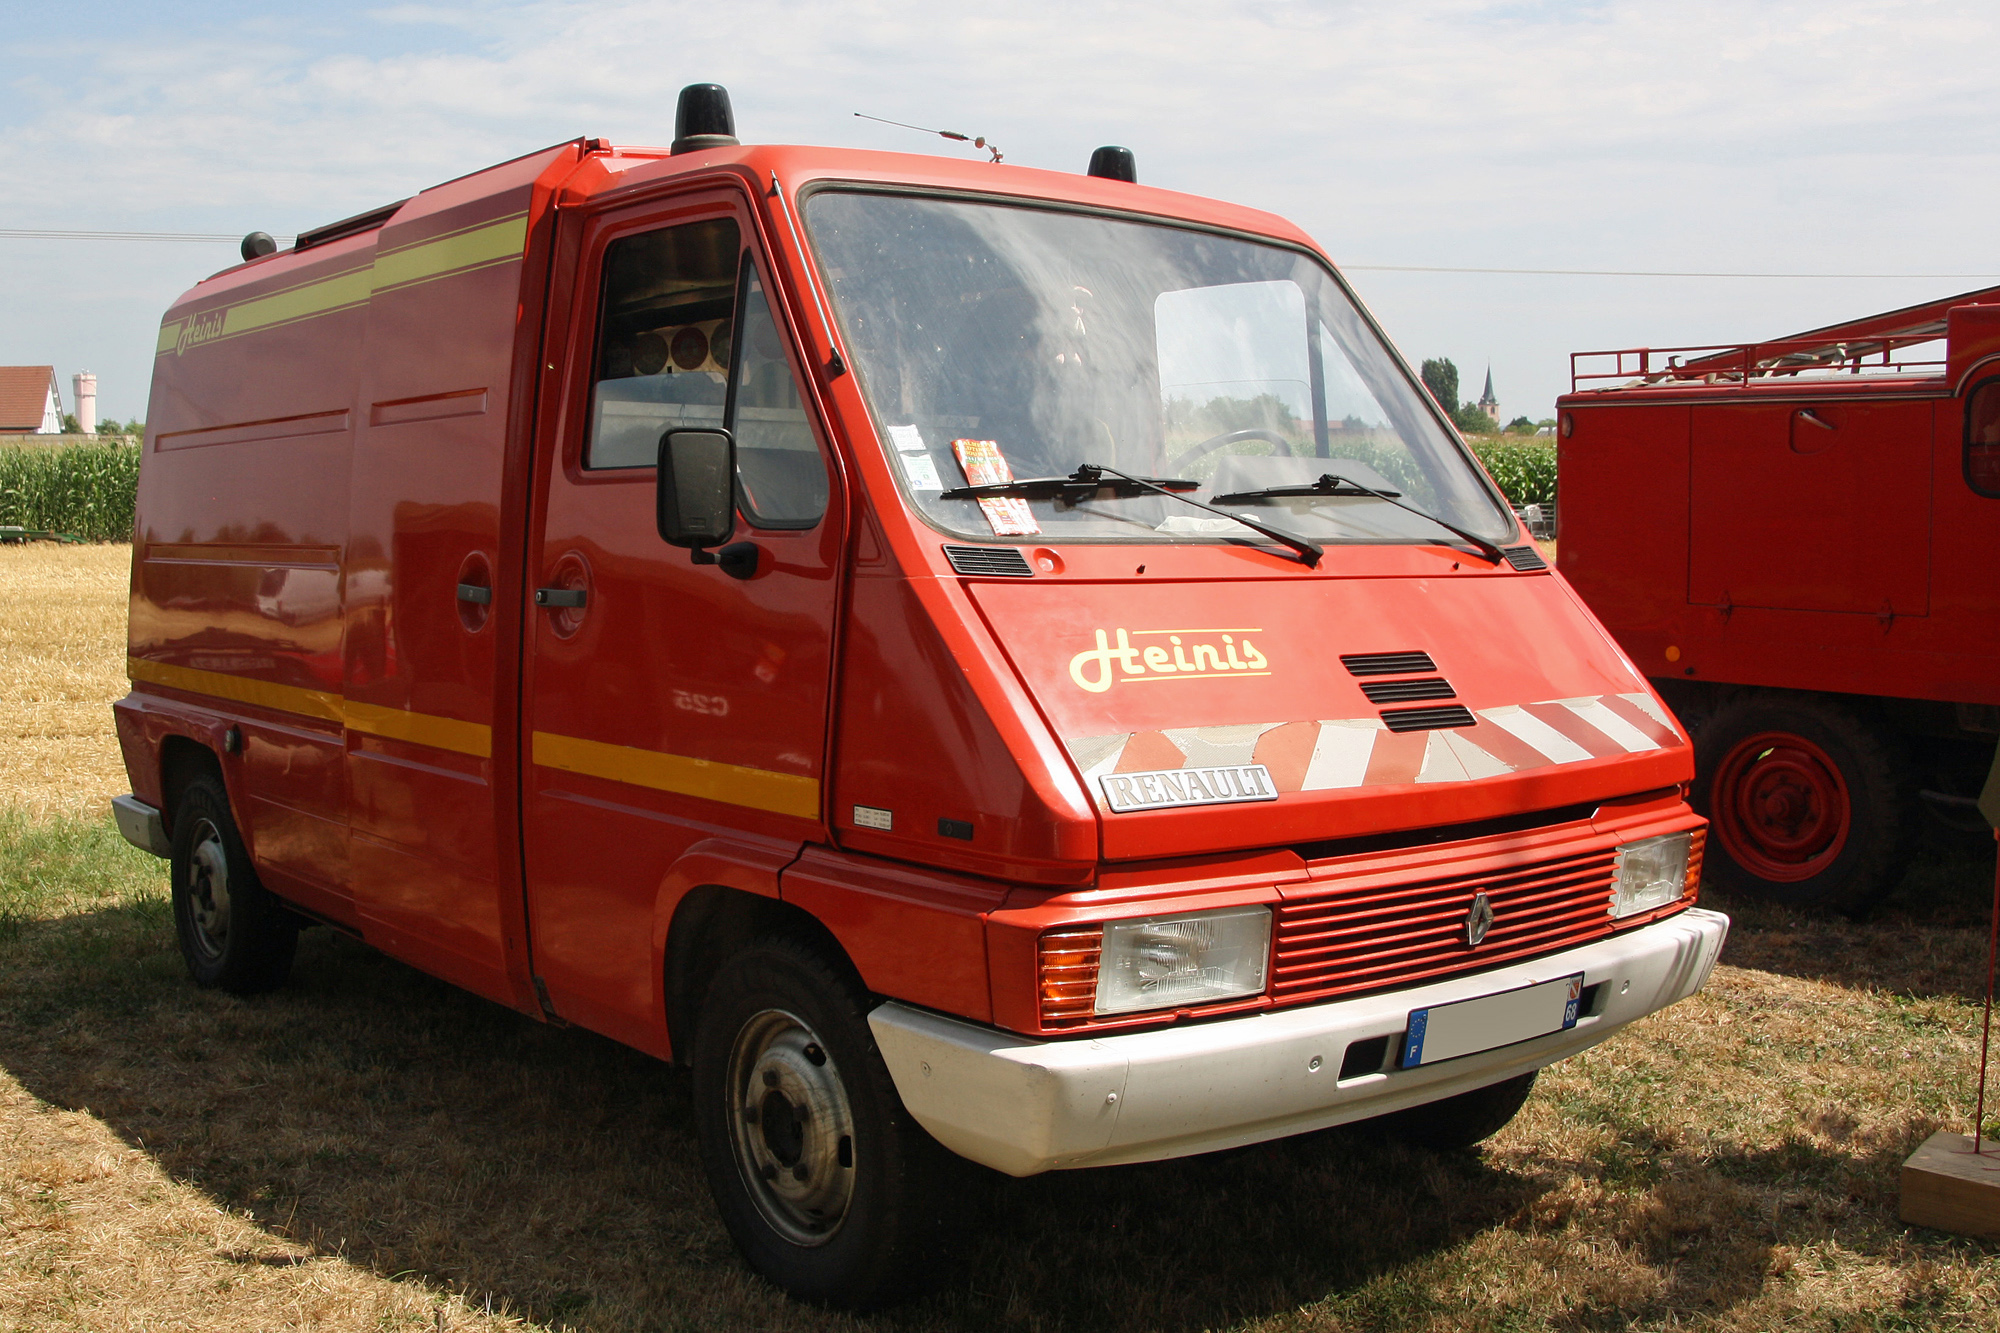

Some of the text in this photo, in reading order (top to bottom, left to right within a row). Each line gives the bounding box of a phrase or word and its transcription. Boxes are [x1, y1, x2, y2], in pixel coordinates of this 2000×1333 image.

[177, 312, 222, 357] Heinis
[1069, 627, 1268, 693] Heinis
[1106, 767, 1270, 807] RENAULT
[1565, 1002, 1578, 1021] 68
[1409, 1045, 1418, 1059] F
